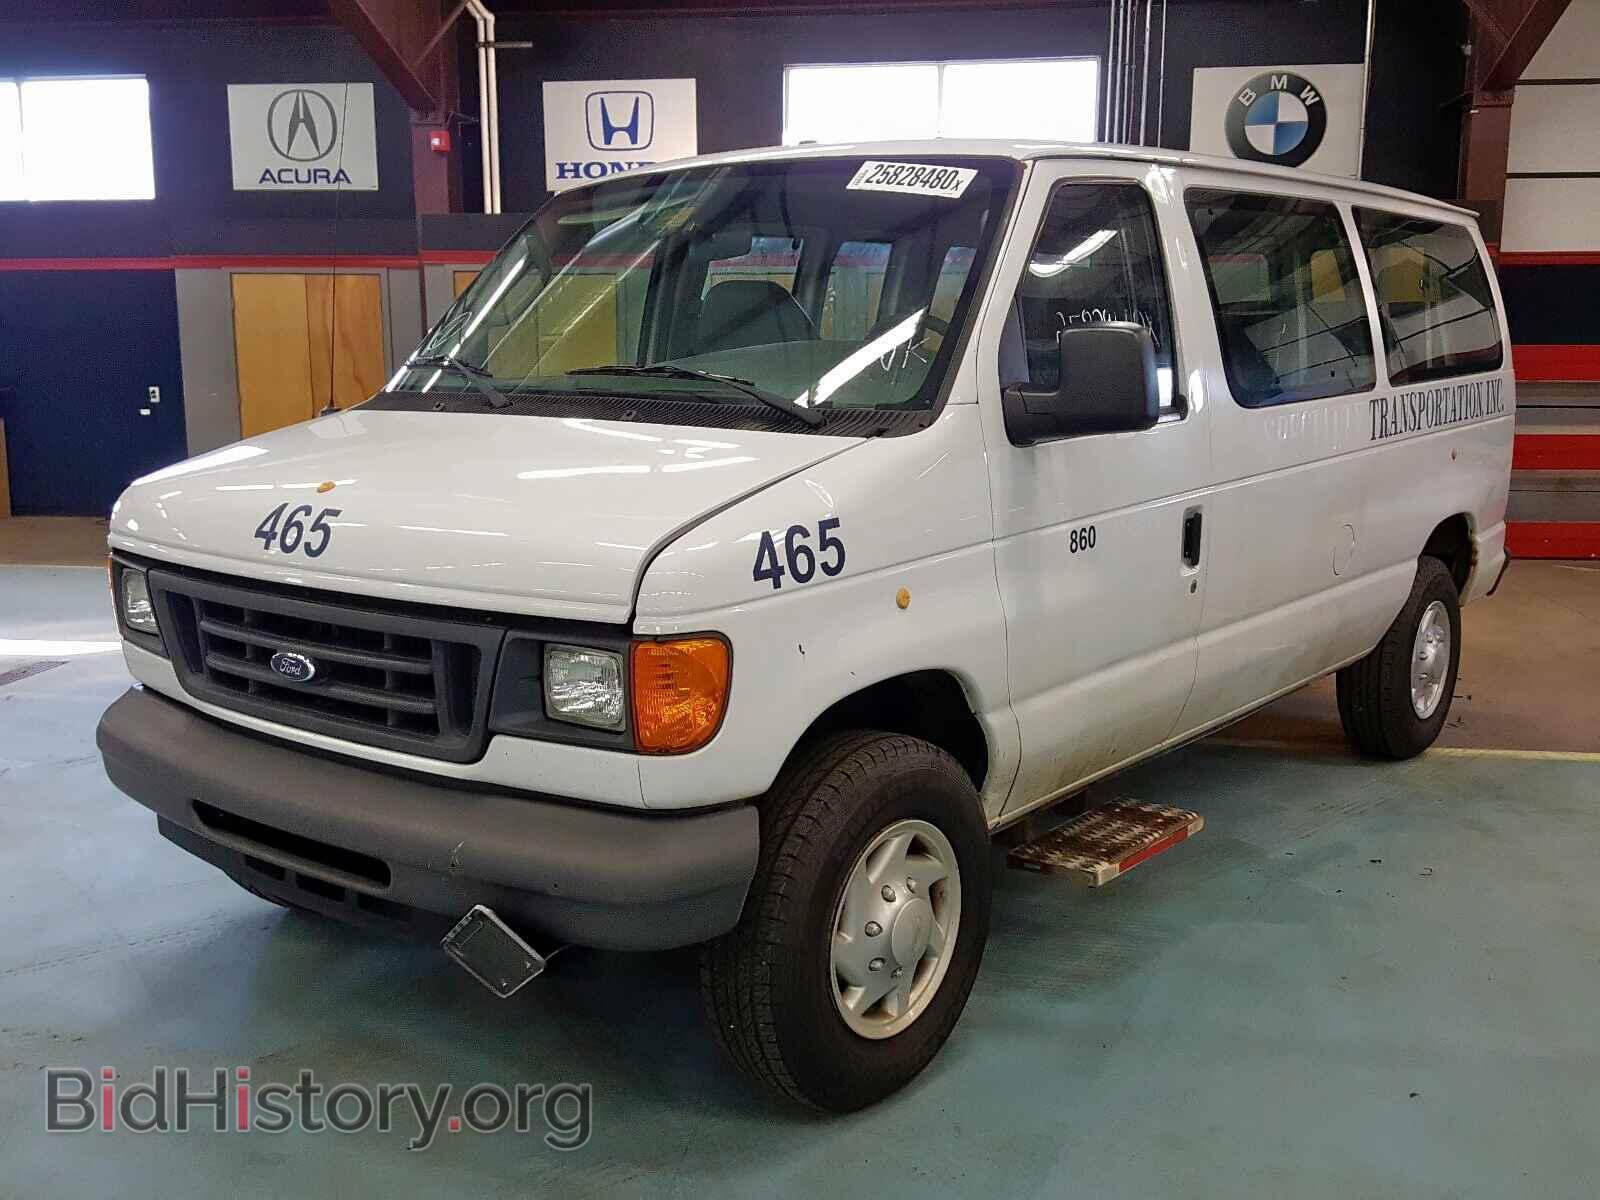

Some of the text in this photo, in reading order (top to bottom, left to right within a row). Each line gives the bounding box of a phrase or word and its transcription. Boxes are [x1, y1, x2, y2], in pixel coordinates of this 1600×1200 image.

[1238, 75, 1321, 106] BMW
[259, 168, 352, 184] ACURA
[255, 502, 342, 558] 465
[1070, 525, 1096, 554] 860
[753, 517, 846, 590] 465
[280, 657, 302, 675] Ford
